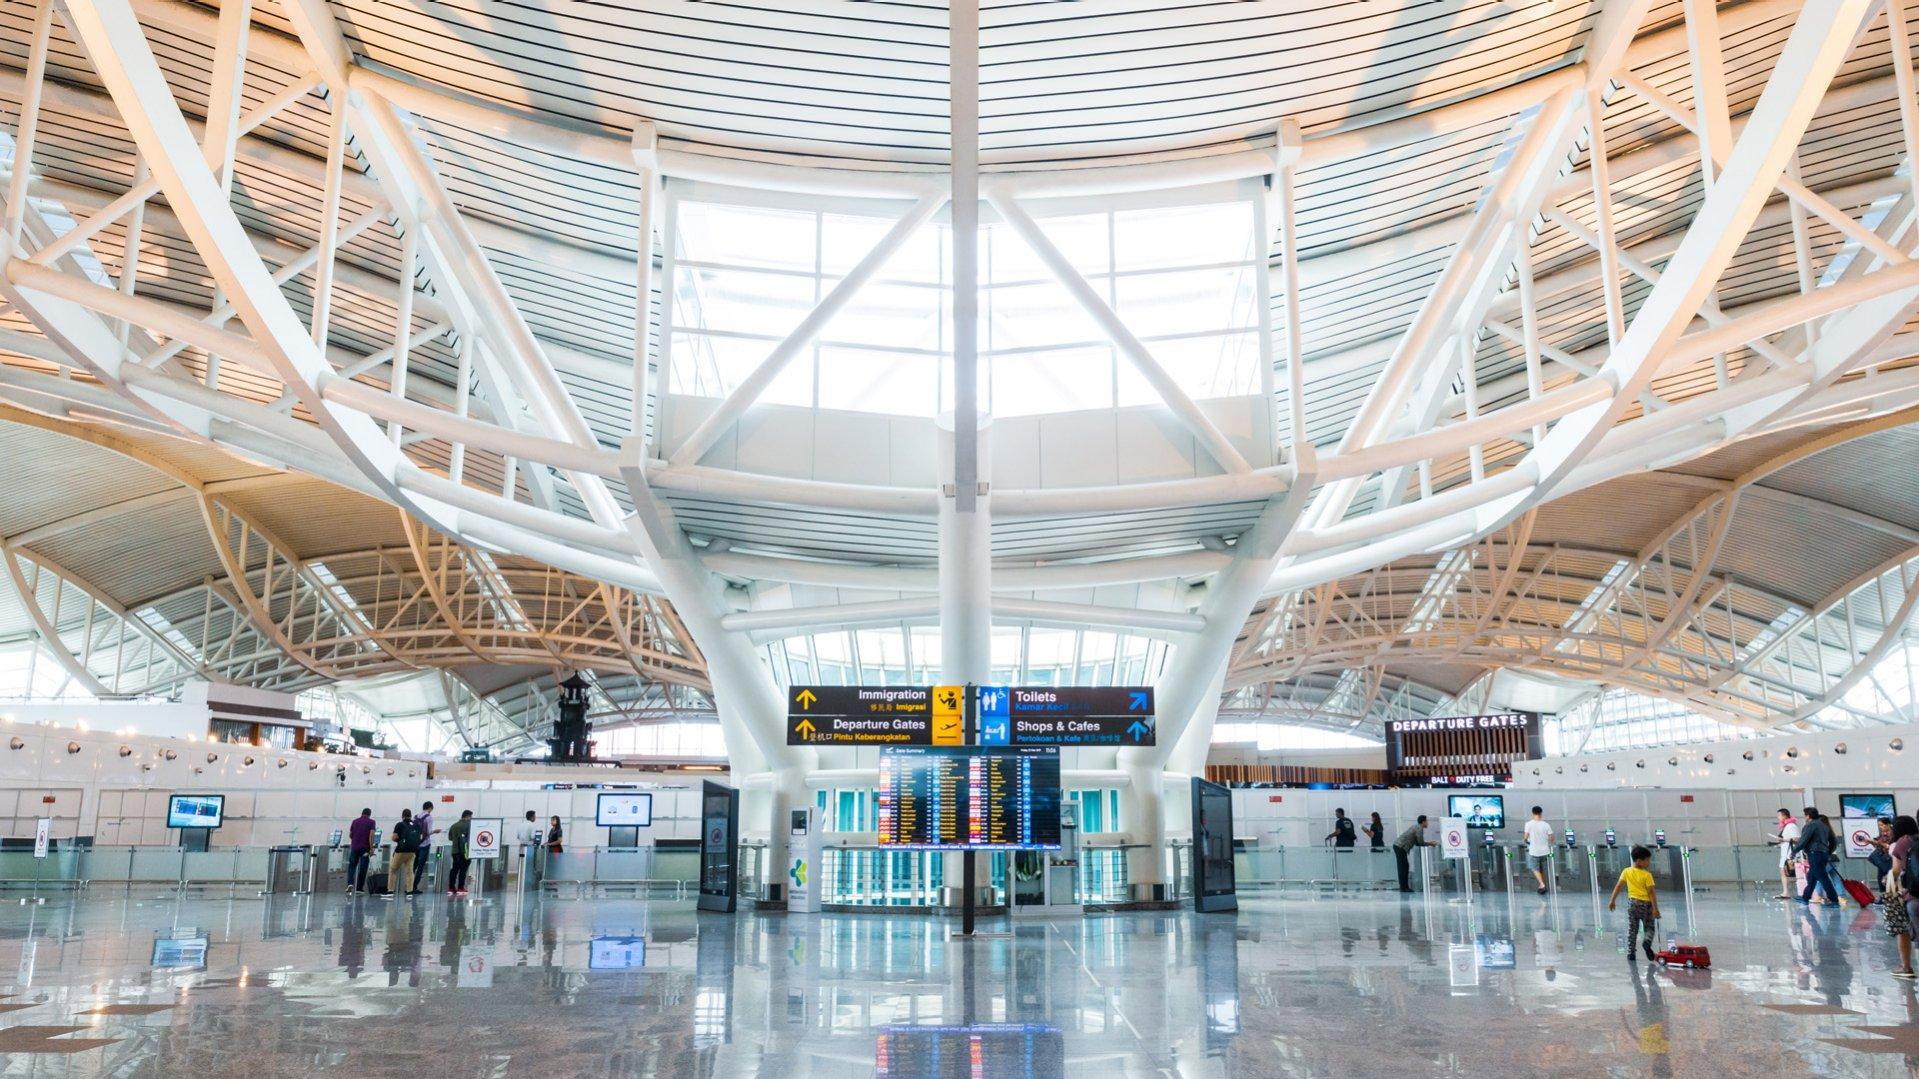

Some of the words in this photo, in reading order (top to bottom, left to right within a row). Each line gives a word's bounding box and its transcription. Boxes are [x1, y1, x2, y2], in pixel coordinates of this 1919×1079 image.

[859, 690, 926, 701] Immigration
[1015, 691, 1056, 702] Toilets
[896, 703, 926, 712] Imigrasi
[833, 719, 890, 731] Departure
[892, 719, 926, 730] Gates
[1016, 721, 1053, 733] Shops
[1056, 721, 1065, 731] &
[1068, 721, 1101, 731] Cafes
[1393, 718, 1474, 732] DEPARTURE
[1479, 715, 1528, 727] GATES
[833, 733, 853, 741] Pintu
[855, 733, 911, 742] Keberangkatan
[1016, 735, 1055, 743] Pertokoan
[1431, 776, 1448, 784] BALI
[1455, 775, 1475, 783] DUTY
[1476, 775, 1495, 783] FREE
